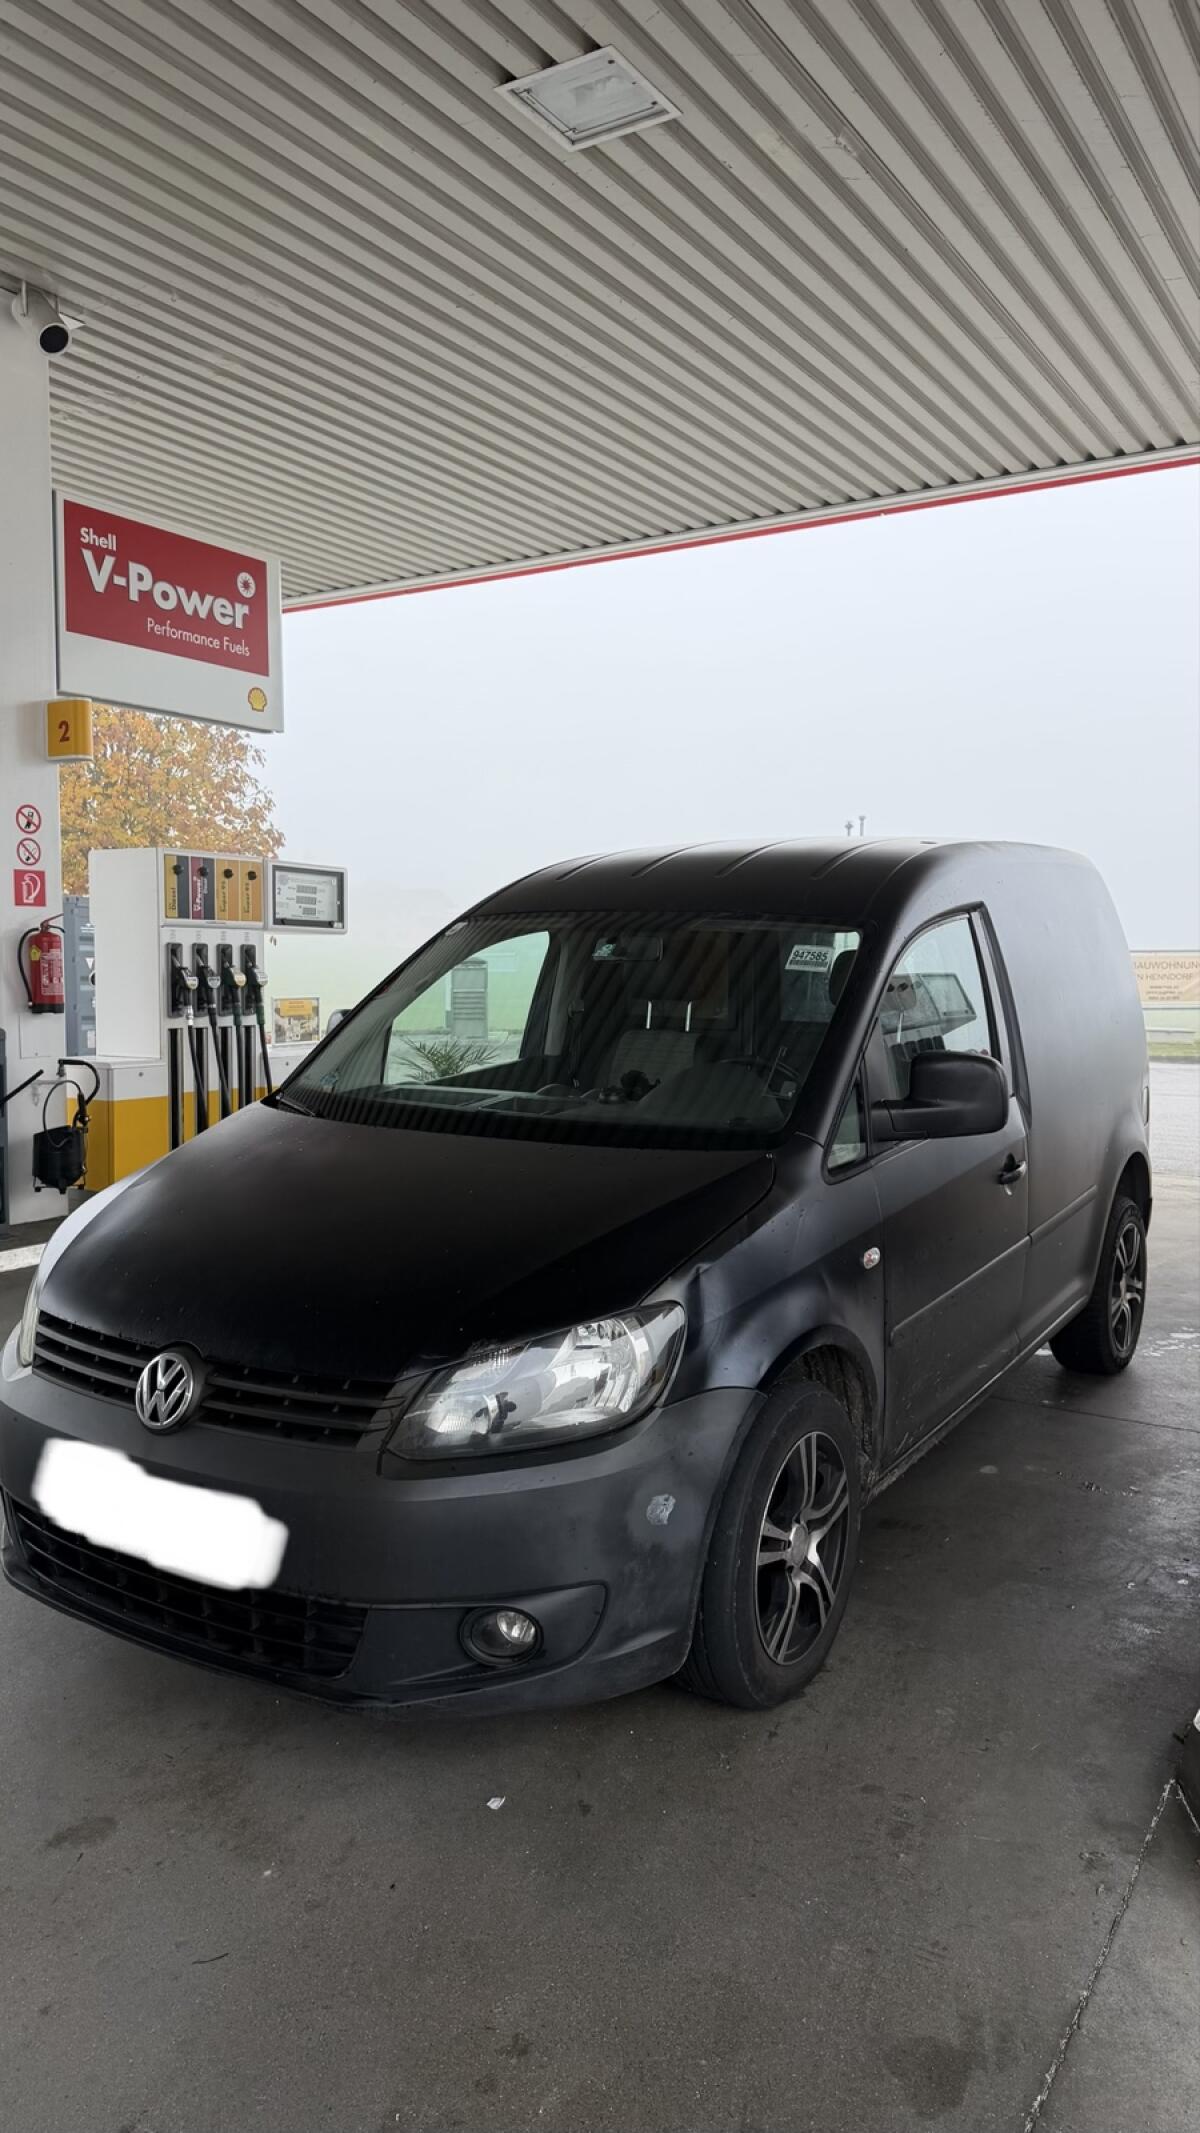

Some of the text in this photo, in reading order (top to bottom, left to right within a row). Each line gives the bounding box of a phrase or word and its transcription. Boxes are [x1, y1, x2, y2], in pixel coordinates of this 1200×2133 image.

[80, 527, 117, 551] Shell
[81, 548, 249, 629] V-Power
[147, 617, 250, 657] Performance Fuels
[58, 720, 70, 743] 2
[792, 950, 829, 961] 947585
